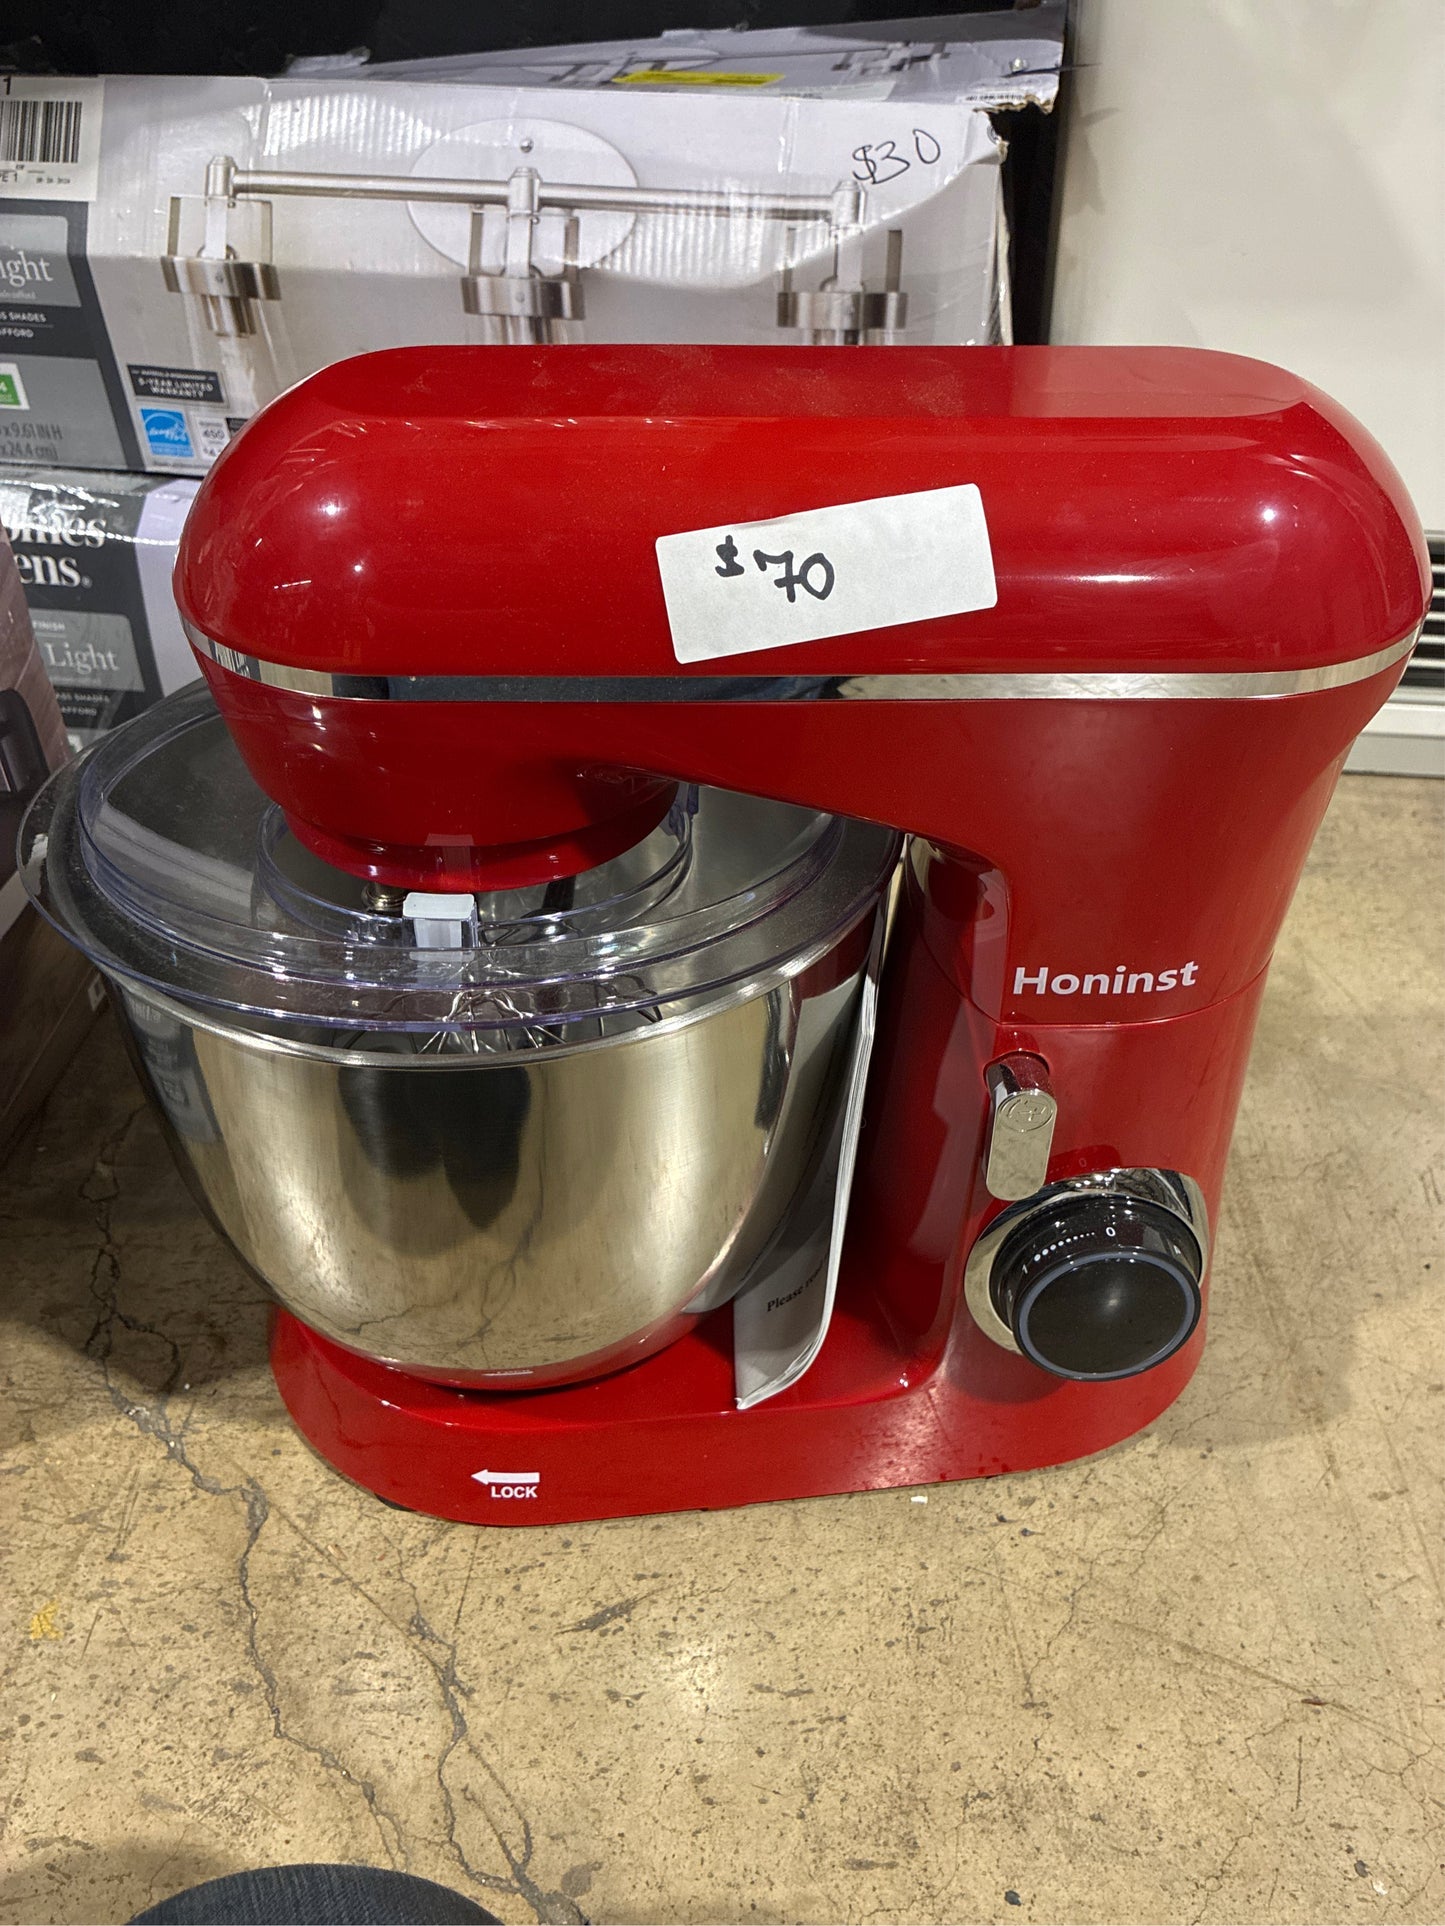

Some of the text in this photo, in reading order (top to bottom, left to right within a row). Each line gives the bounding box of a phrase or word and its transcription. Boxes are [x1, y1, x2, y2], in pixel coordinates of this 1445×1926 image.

[852, 128, 941, 185] $30
[8, 312, 47, 322] SHADES
[715, 535, 835, 603] $70
[44, 641, 119, 674] Light
[1013, 961, 1199, 995] Honinst
[1106, 1226, 1116, 1237] 0
[767, 1285, 804, 1312] Please
[491, 1486, 538, 1498] LOCK
